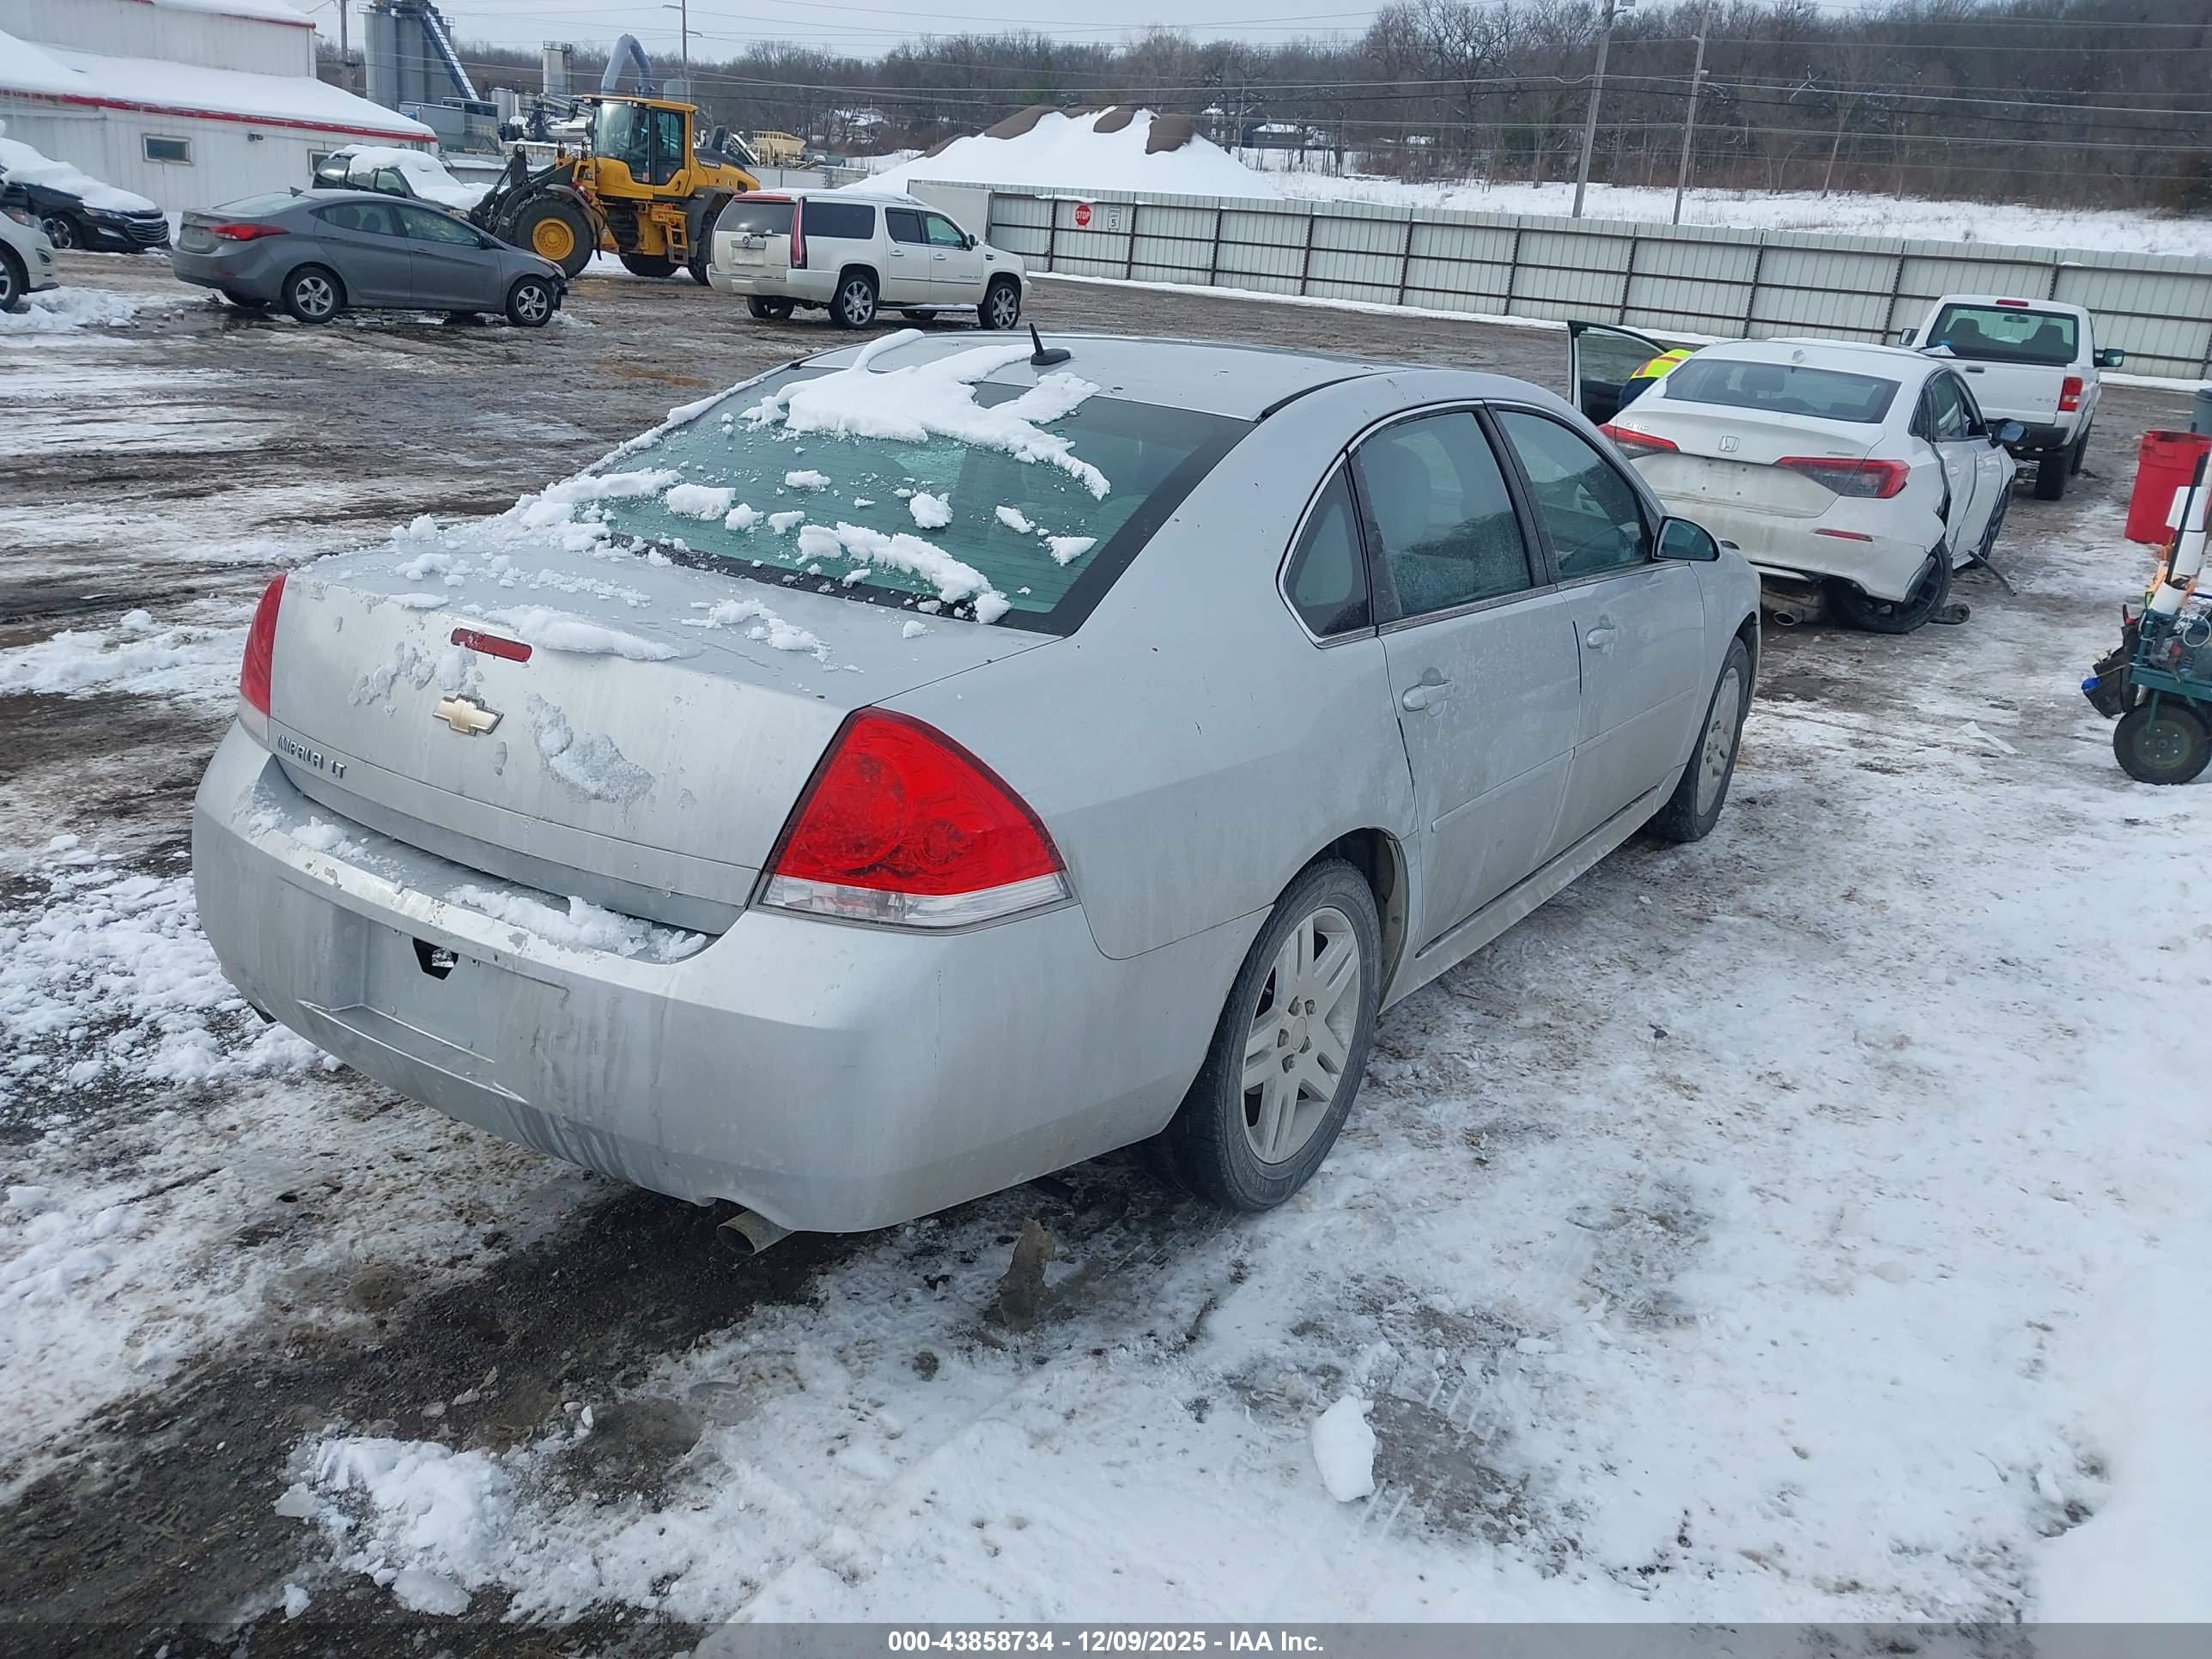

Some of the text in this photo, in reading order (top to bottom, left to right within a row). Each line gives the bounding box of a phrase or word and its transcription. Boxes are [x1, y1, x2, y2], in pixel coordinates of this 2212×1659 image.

[699, 160, 720, 169] VOLVO
[1076, 210, 1091, 221] STOP
[1624, 421, 1650, 431] CIVIC
[277, 733, 347, 779] IMPALA LT
